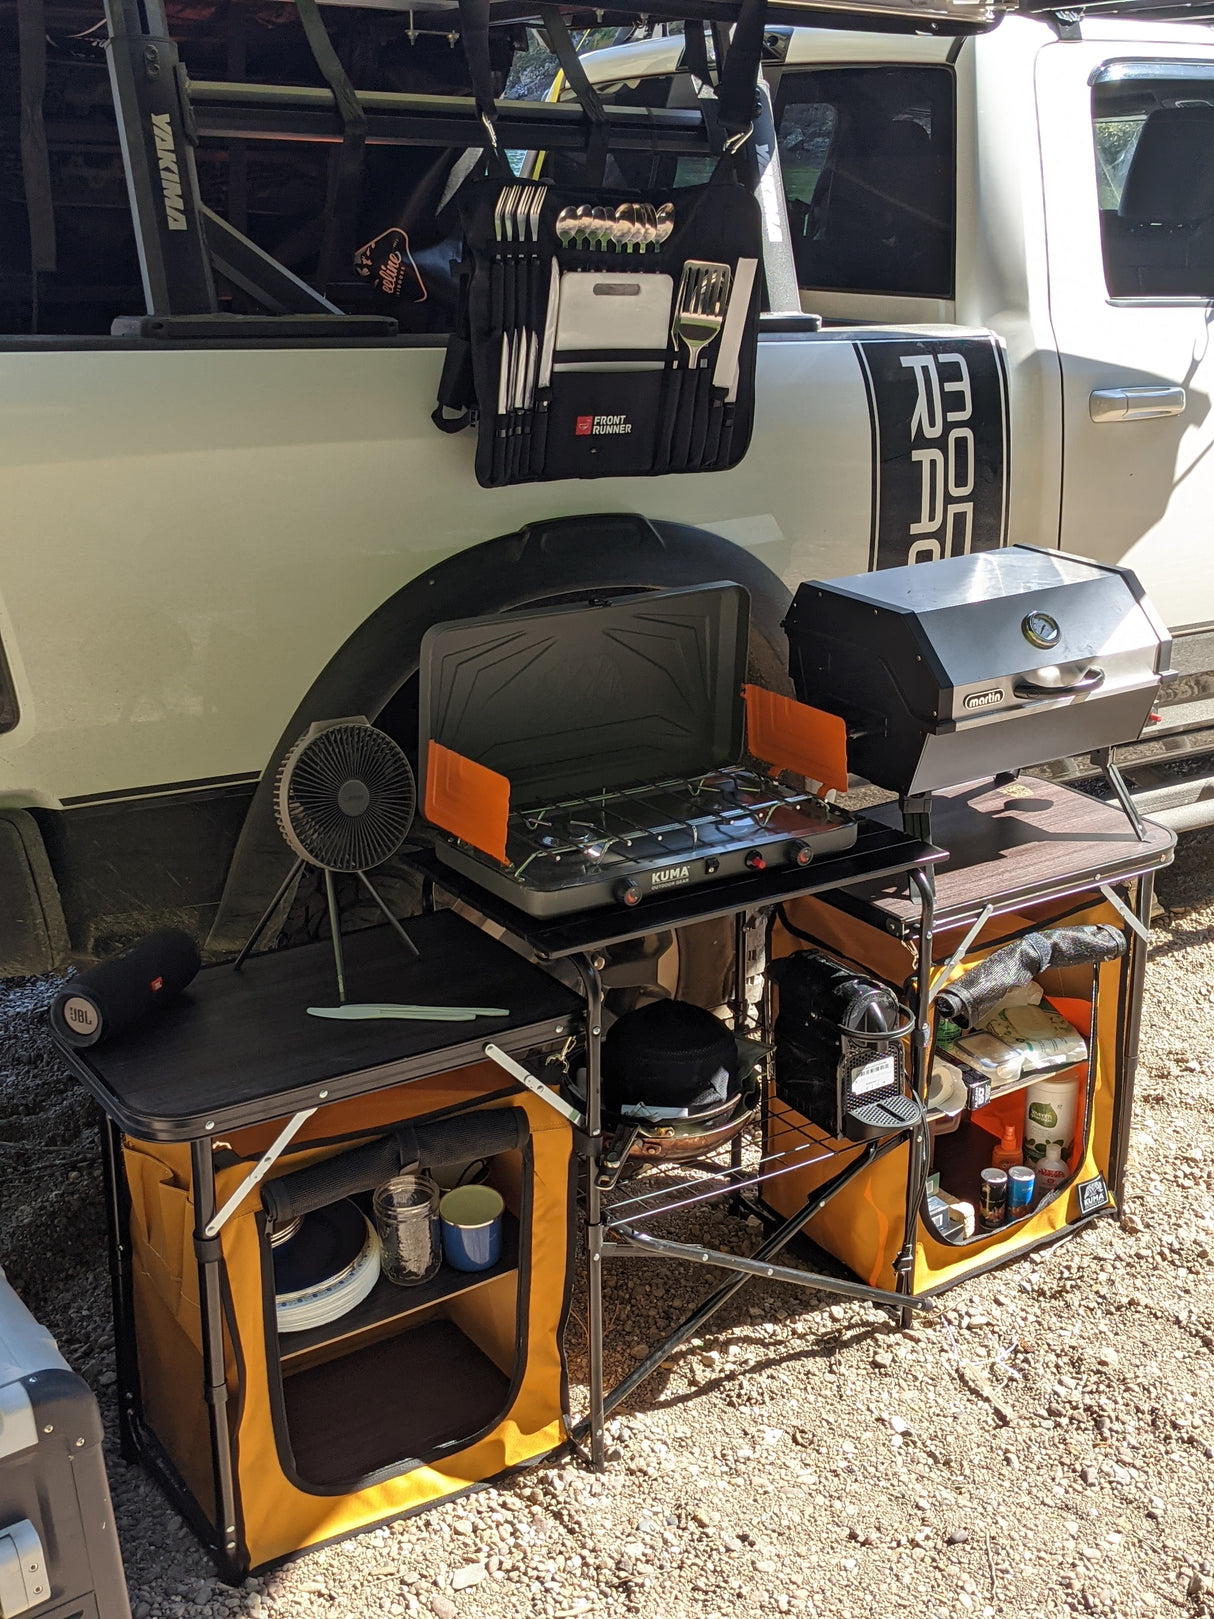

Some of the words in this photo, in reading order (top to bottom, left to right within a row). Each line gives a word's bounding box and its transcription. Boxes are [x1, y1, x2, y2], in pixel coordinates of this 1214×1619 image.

[151, 113, 187, 230] YAKIMA
[594, 415, 626, 425] FRONT
[592, 423, 632, 435] RUNNER
[968, 690, 1001, 708] martin
[652, 866, 689, 883] KUMA
[70, 1007, 92, 1025] JBL
[1083, 1192, 1105, 1206] KUMA
